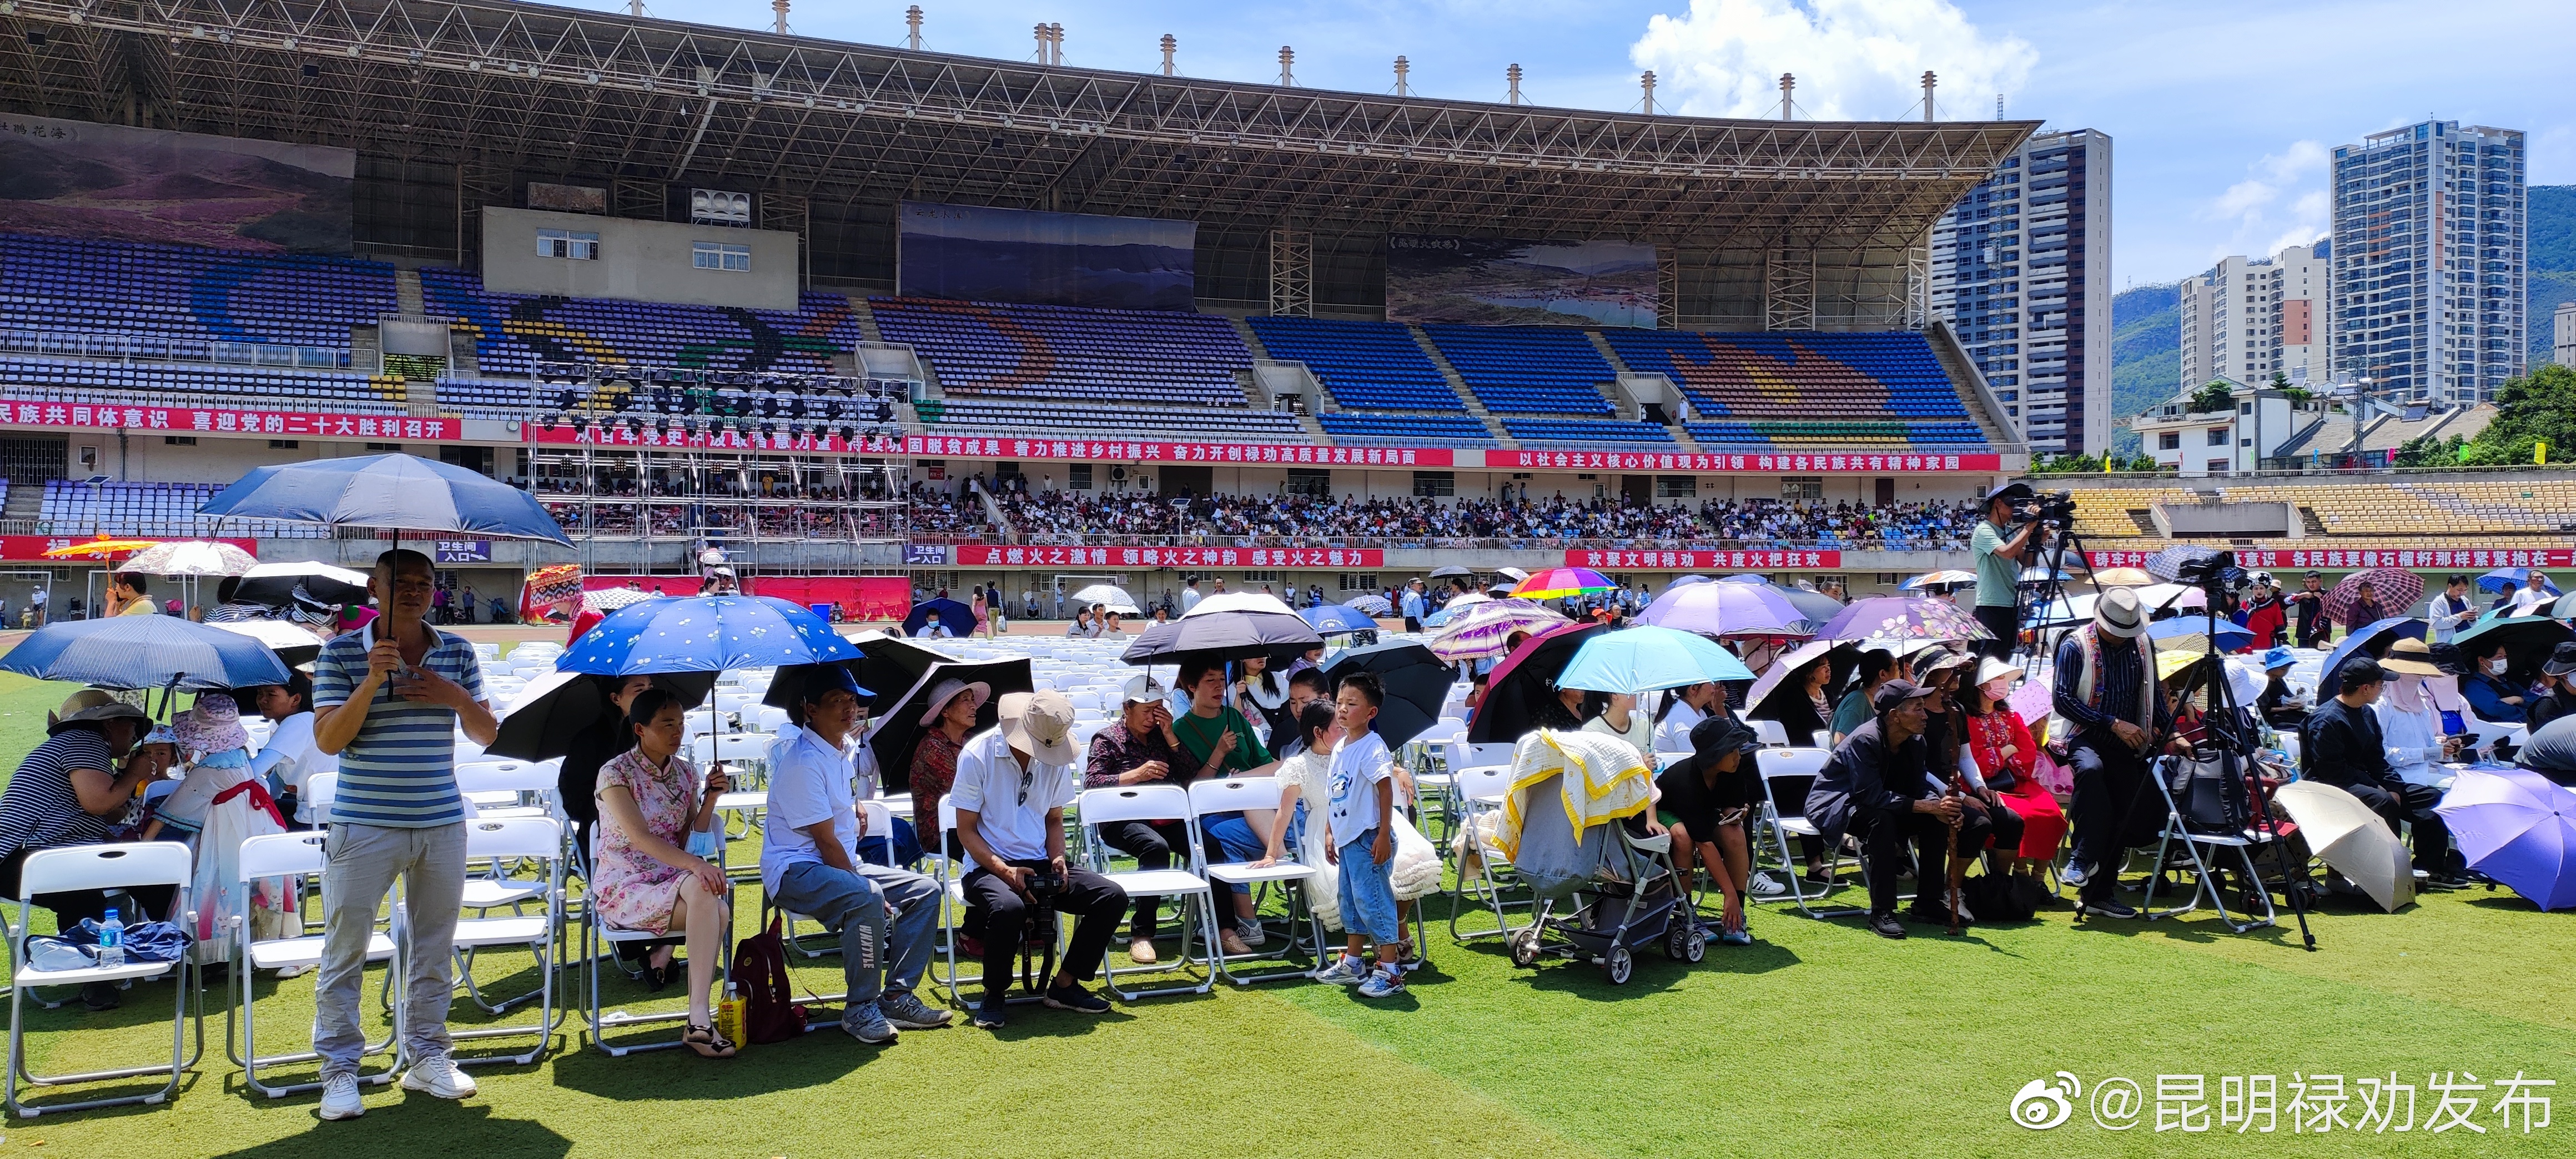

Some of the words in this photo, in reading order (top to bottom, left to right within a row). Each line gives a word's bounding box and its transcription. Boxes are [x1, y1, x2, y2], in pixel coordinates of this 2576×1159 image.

[0, 404, 169, 429] 民族共同体意识
[192, 411, 444, 439] 喜迎党的二十大胜利召开
[847, 434, 1000, 456] 持续巩固脱贫成果
[1014, 440, 1160, 460] 着力推进乡村振兴
[1173, 445, 1416, 465] 奋力开创禄劝高质量发展新局面
[1518, 452, 1745, 471] 以社会主义核心价值观为引领
[1758, 455, 1960, 471] 构建各民族共有精神家园
[437, 541, 476, 552] 卫生间
[914, 546, 945, 555] 卫生间
[444, 552, 470, 562] 入口
[920, 555, 942, 565] 入口
[985, 547, 1108, 565] 点燃火之激情
[1122, 548, 1237, 566] 领略火之神韵
[1251, 550, 1363, 566] 感受火之魅力
[1587, 551, 1695, 568] 欢聚文明禄劝
[1713, 552, 1821, 568] 共度火把狂欢
